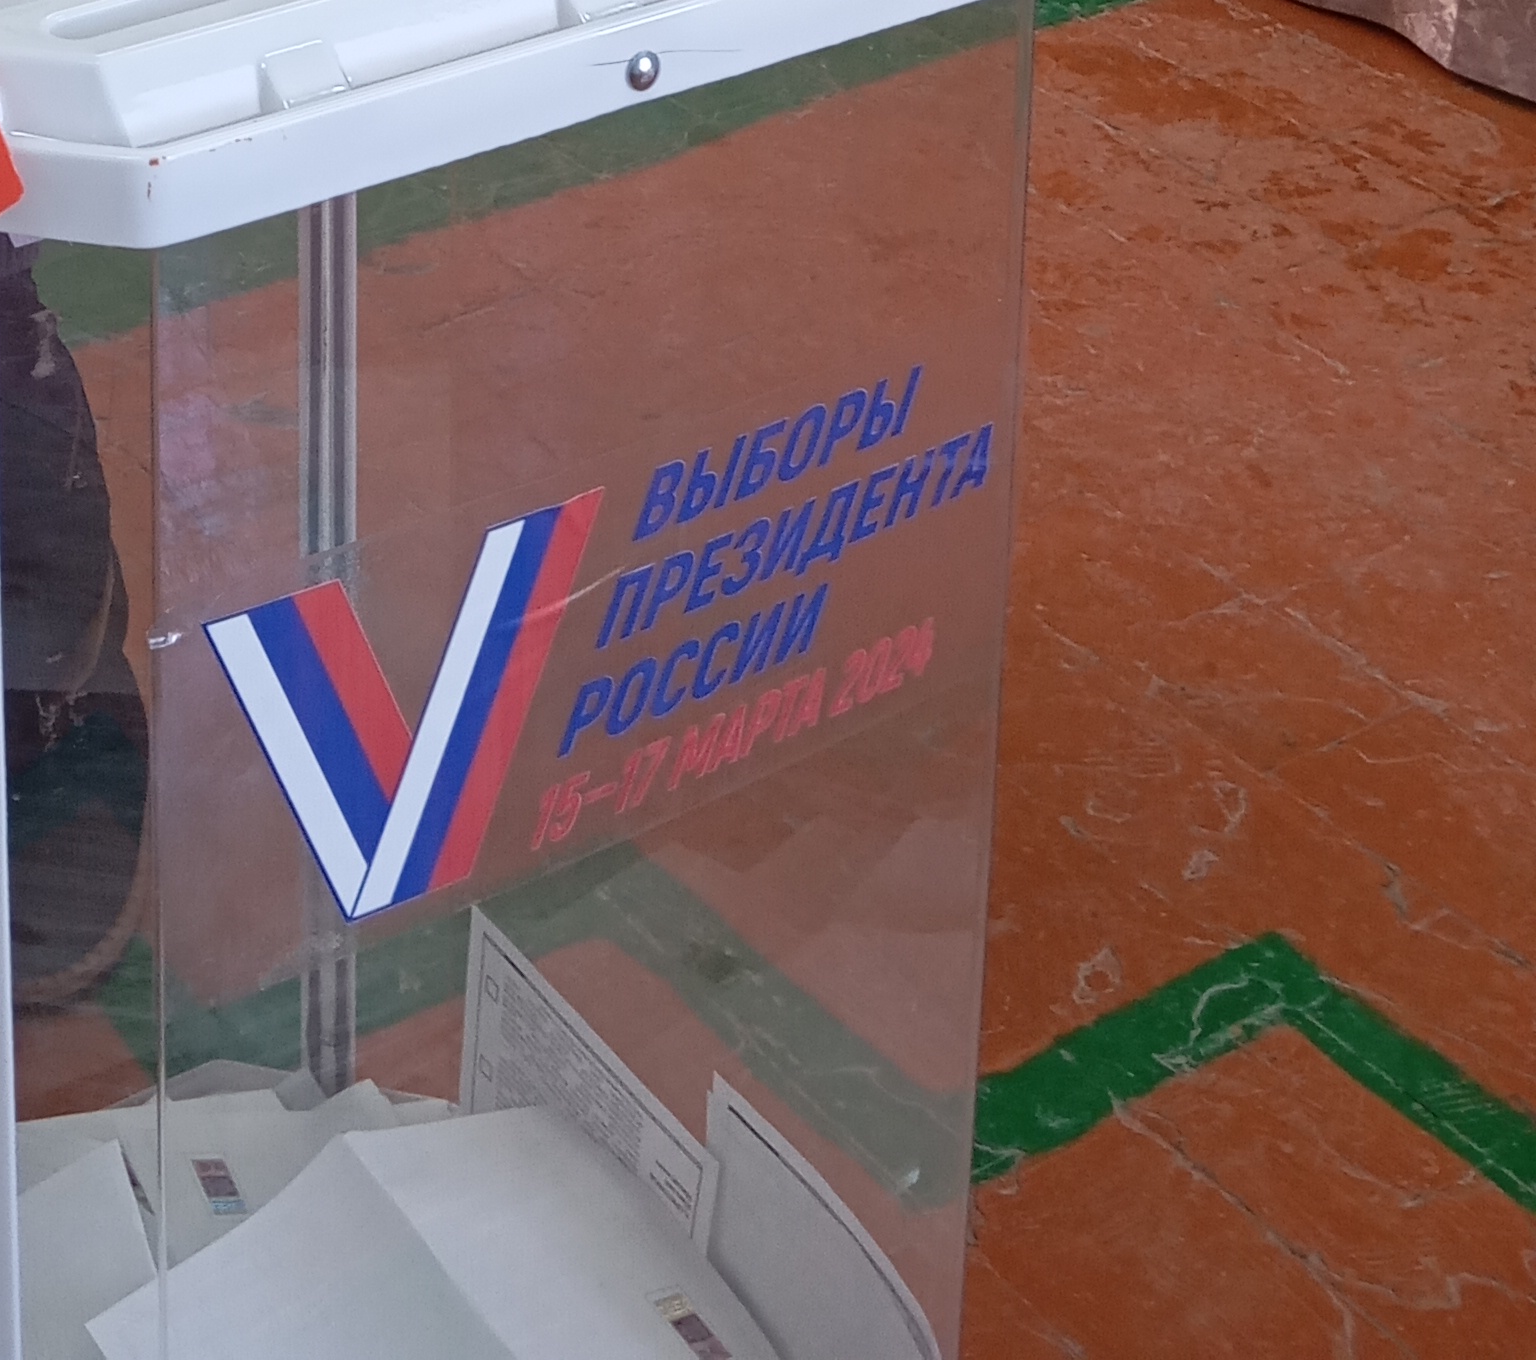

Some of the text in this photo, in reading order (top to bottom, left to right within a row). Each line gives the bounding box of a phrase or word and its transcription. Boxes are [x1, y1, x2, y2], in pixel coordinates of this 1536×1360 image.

[595, 421, 995, 650] ПРЕЗИДЕНТА
[631, 364, 924, 542] ВЫБОРЫ
[557, 582, 829, 759] РОССИИ
[668, 667, 827, 792] МАРТА
[829, 616, 935, 718] 2024
